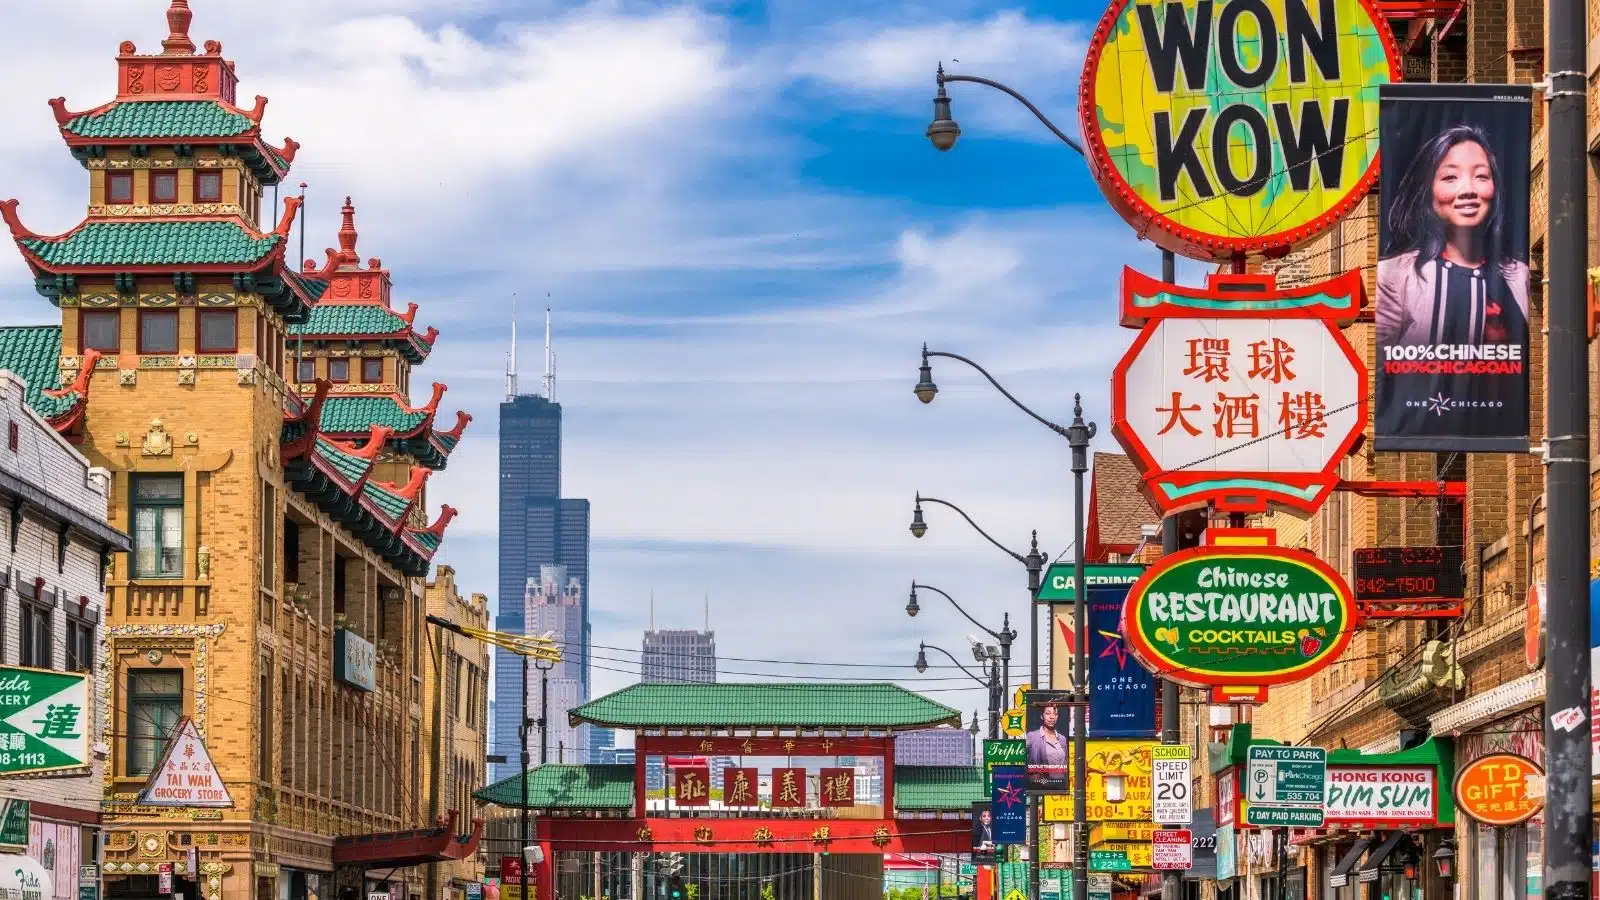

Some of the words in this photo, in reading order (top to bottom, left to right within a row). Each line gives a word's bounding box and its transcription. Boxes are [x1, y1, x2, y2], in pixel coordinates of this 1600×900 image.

[1137, 0, 1340, 92] WON
[1153, 99, 1350, 201] KOW
[1384, 344, 1521, 360] 100%CHINESE
[1183, 337, 1296, 384] 環球
[1384, 360, 1521, 375] 100%CHICAGOAN
[1406, 400, 1428, 408] ONE
[1450, 400, 1503, 408] CHICAGO
[1155, 391, 1328, 440] 大酒樓
[1197, 566, 1289, 588] Chinese
[1148, 591, 1336, 625] RESTAURANT
[1188, 629, 1296, 644] COCKTAILS
[32, 704, 81, 739] 達
[987, 742, 1025, 760] Triple
[1255, 750, 1273, 758] PAY
[1276, 750, 1290, 759] TO
[1293, 751, 1320, 759] PARK
[1156, 762, 1187, 770] SPEED
[166, 774, 183, 786] TAI
[188, 775, 212, 787] WAH
[1159, 772, 1184, 780] LIMIT
[1331, 773, 1377, 782] HONG
[1381, 773, 1426, 782] KONG
[155, 788, 192, 799] GROCERY
[198, 789, 223, 800] STORE
[1157, 783, 1187, 800] 20
[1327, 783, 1374, 808] DIM
[1377, 784, 1431, 808] SUM
[1250, 812, 1255, 820] 7
[1256, 811, 1271, 820] DAY
[1271, 812, 1288, 820] PAID
[1290, 812, 1322, 821] PARKING
